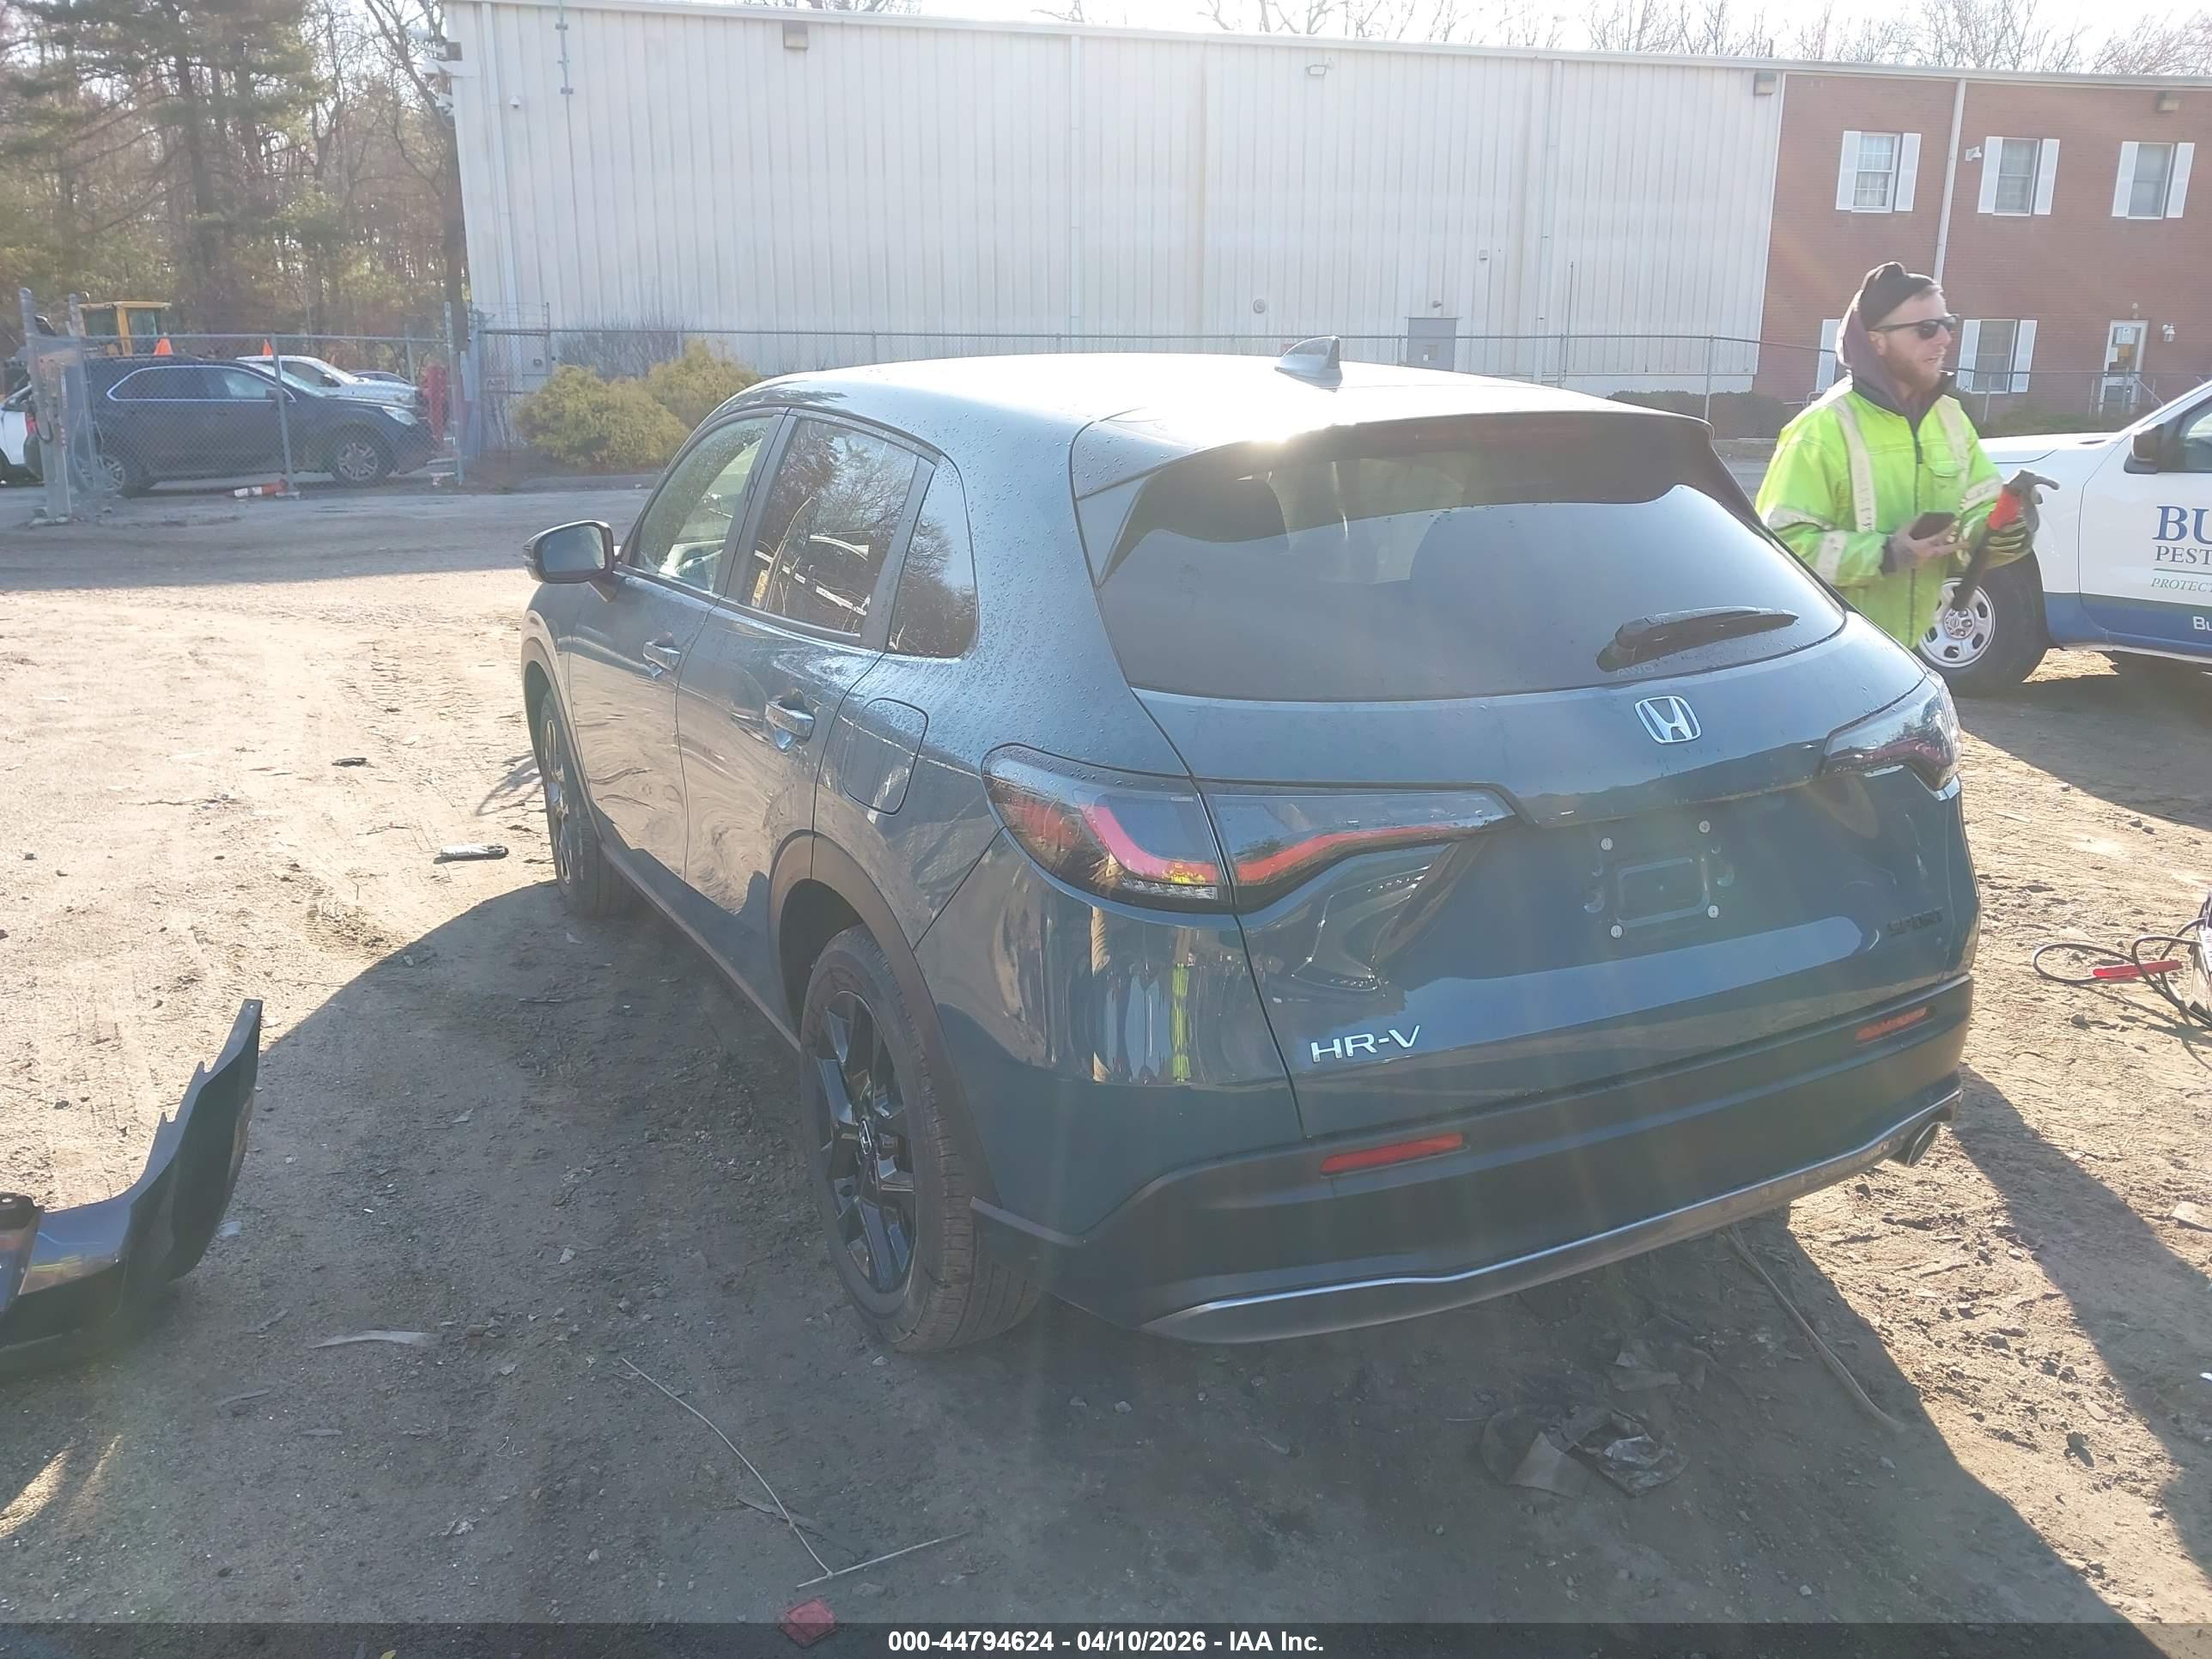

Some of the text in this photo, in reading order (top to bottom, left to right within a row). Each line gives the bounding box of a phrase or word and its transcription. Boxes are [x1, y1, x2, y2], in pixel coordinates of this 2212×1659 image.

[2152, 505, 2212, 545] BU
[2154, 545, 2212, 566] PEST
[1310, 1024, 1420, 1063] HR-V
